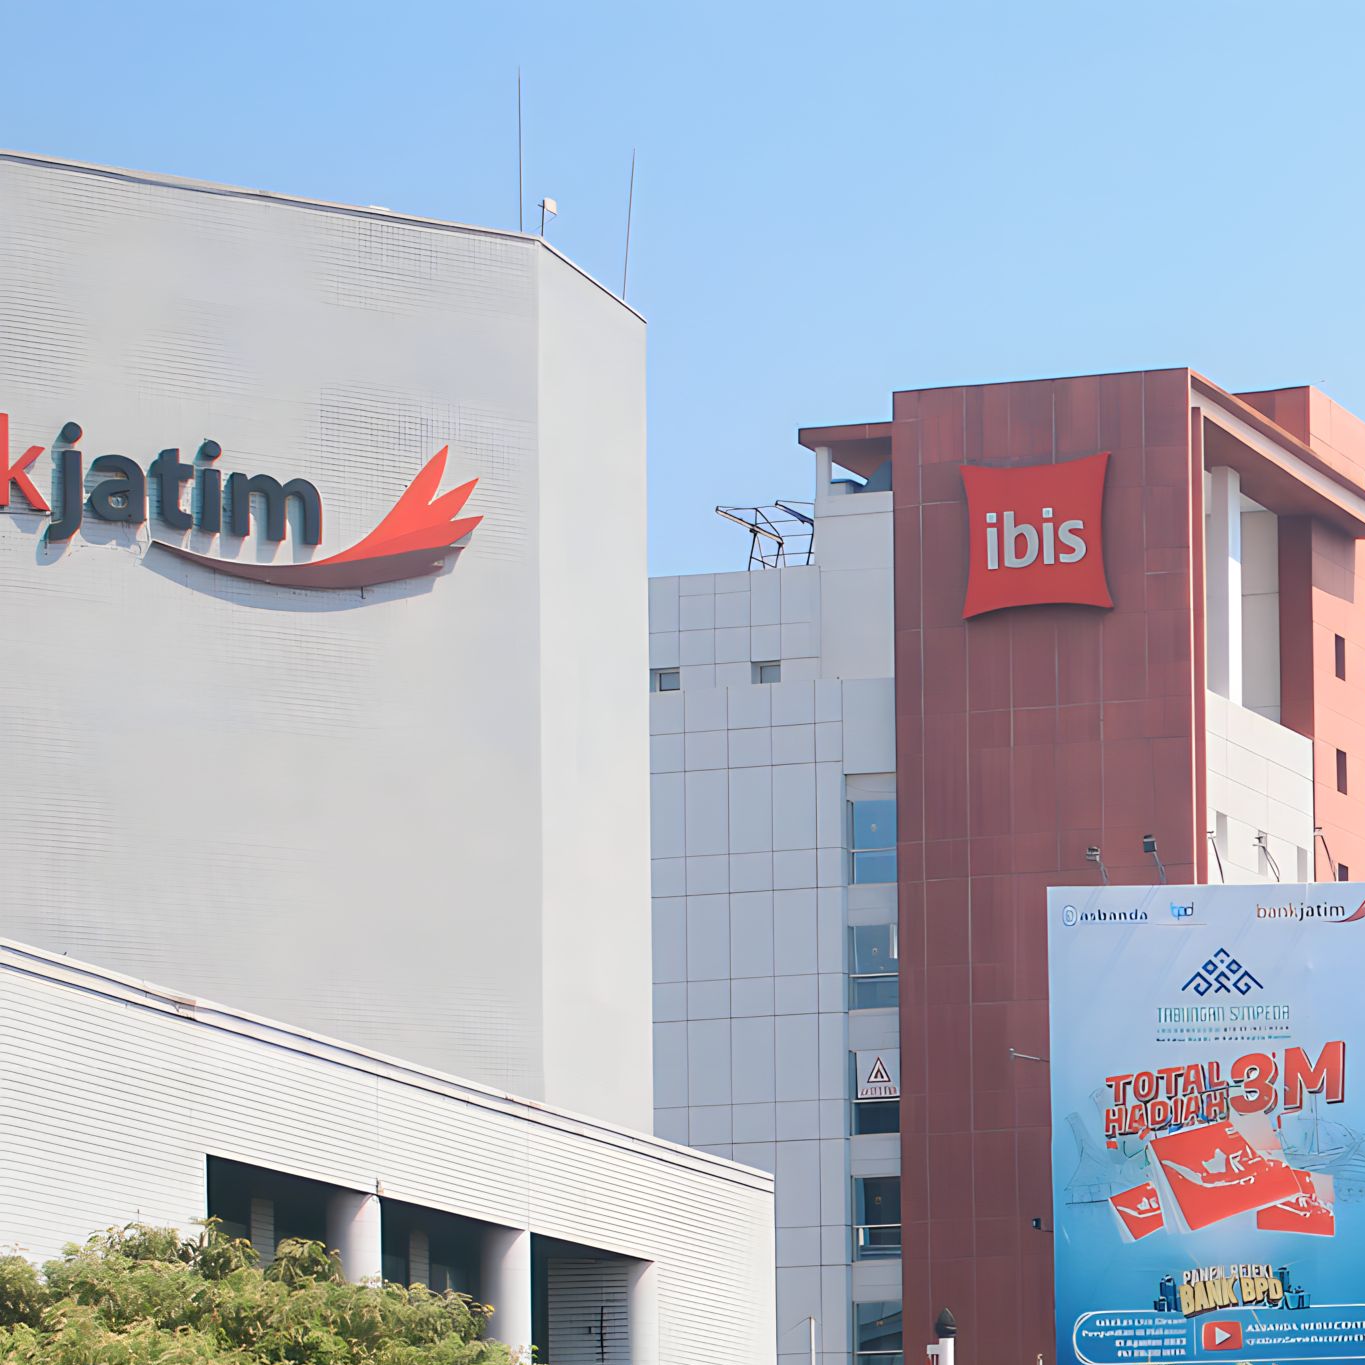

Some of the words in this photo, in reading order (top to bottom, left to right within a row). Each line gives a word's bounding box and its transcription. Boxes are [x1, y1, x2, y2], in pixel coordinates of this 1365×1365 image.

[0, 413, 323, 545] kjatim
[985, 507, 1087, 570] ibis
[1105, 1060, 1229, 1105] TOTAL
[1230, 1041, 1345, 1116] 3M
[1104, 1090, 1230, 1138] HADIAH
[1179, 1278, 1239, 1316] BANK
[1240, 1277, 1284, 1305] BPD
